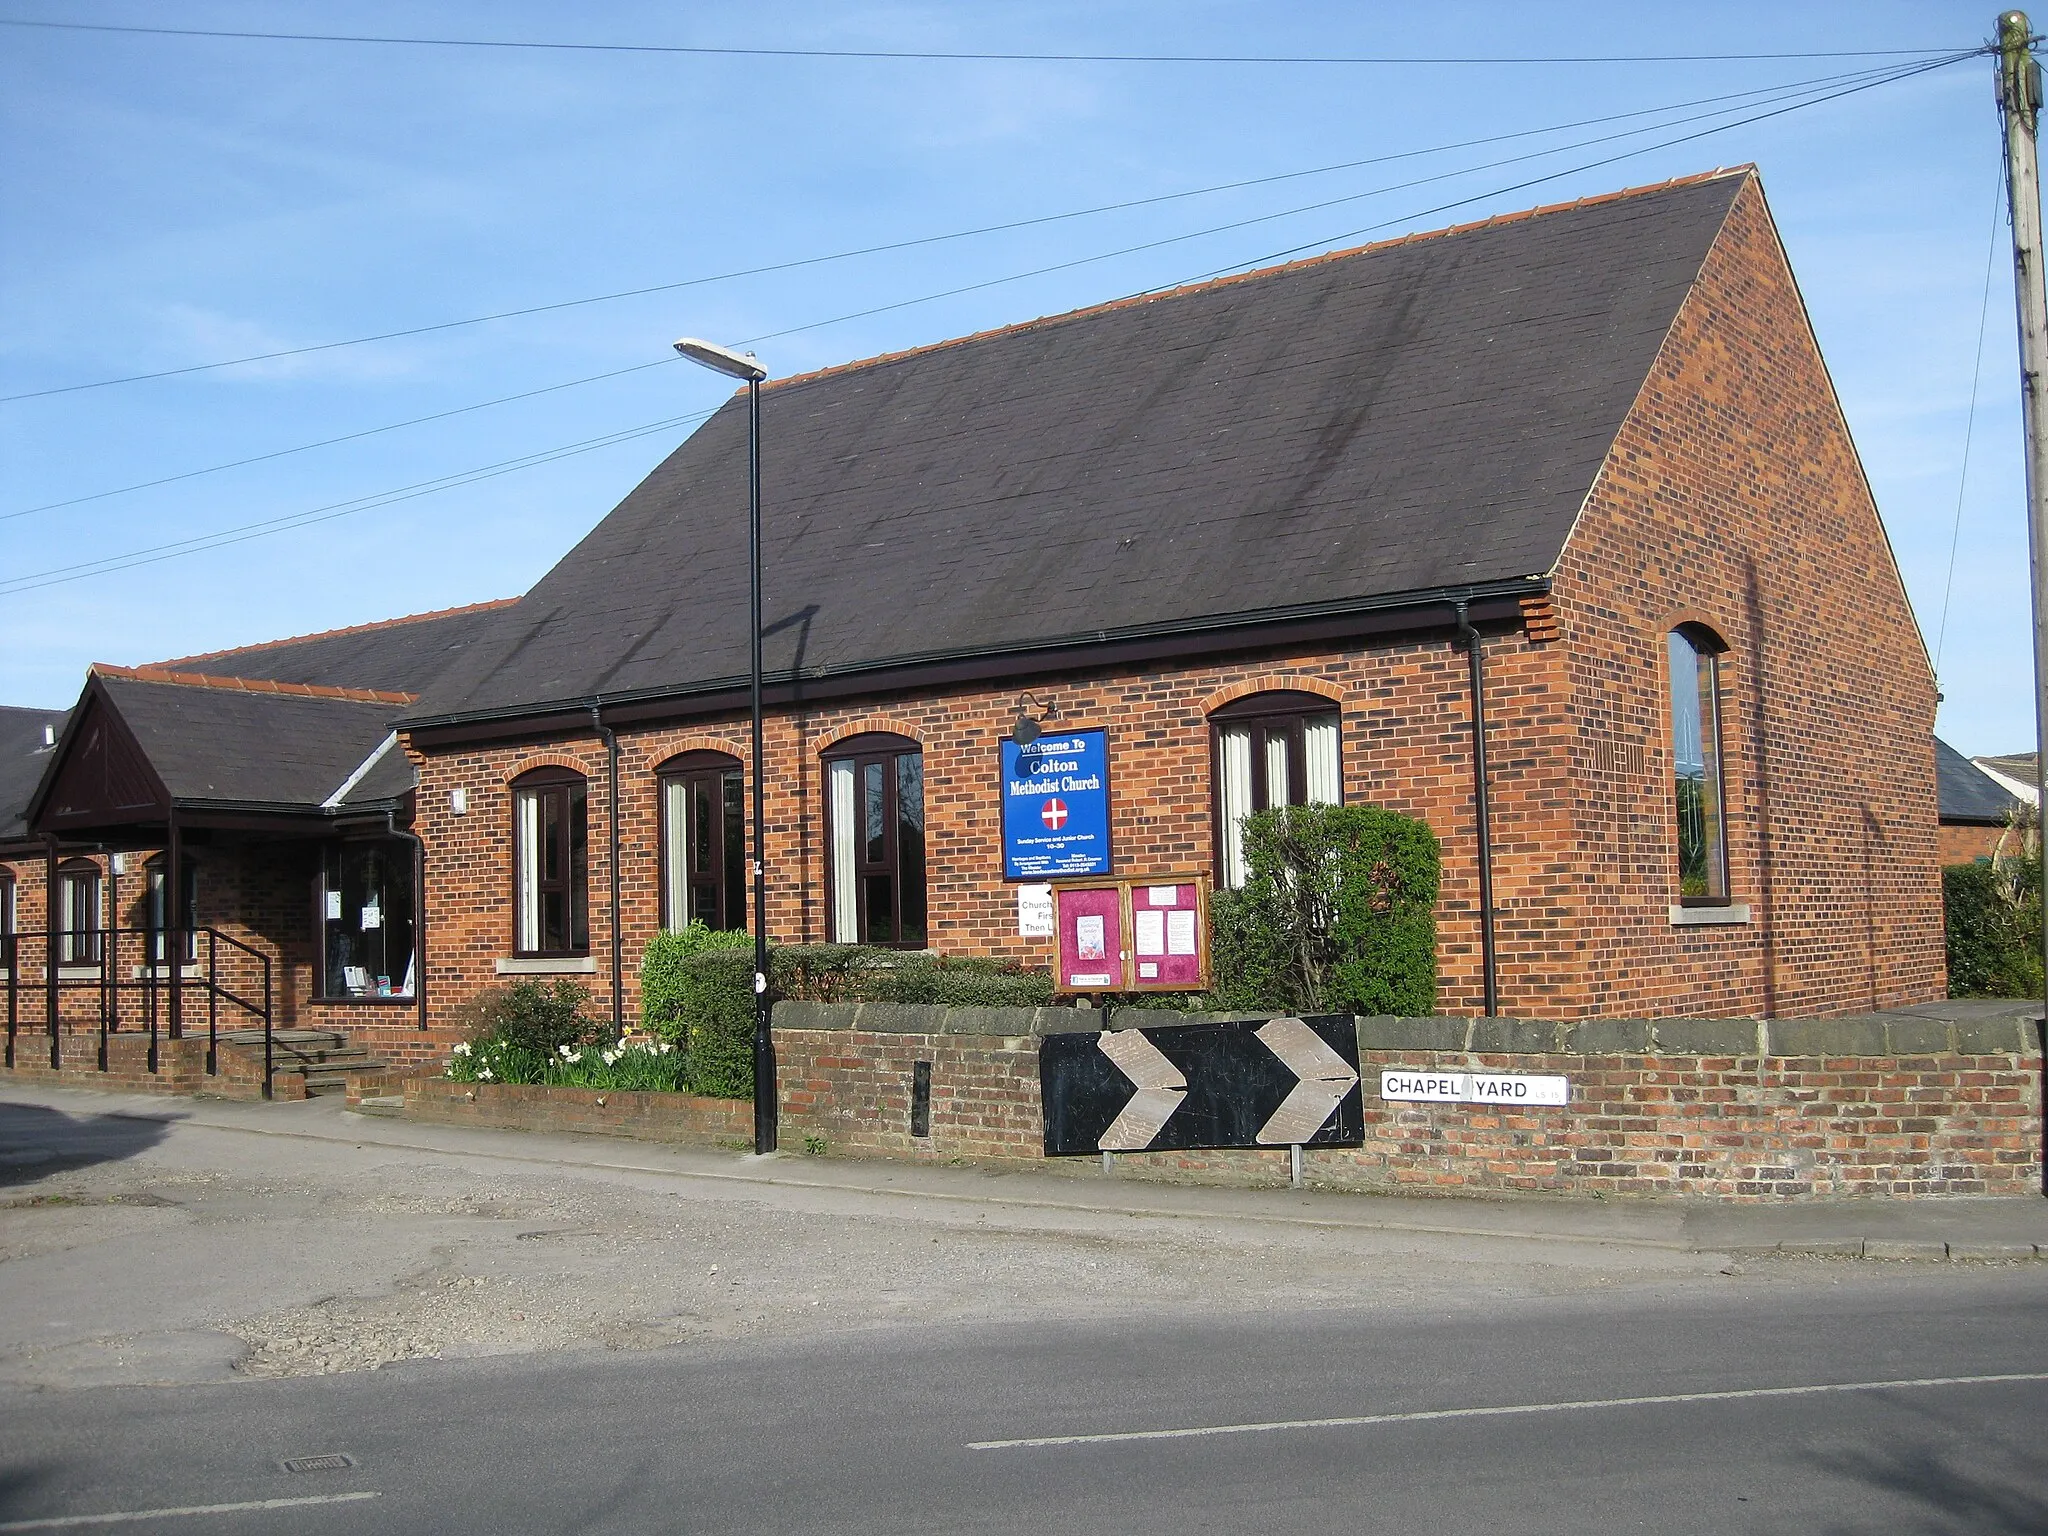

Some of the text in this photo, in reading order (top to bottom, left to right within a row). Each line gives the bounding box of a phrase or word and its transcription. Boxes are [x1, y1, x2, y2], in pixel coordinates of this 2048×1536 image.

[1021, 739, 1085, 753] Welcome To
[1030, 759, 1078, 775] Colton
[1010, 774, 1100, 796] Methodist Church
[1021, 901, 1053, 909] Church
[1037, 911, 1053, 920] Firs
[1025, 923, 1045, 931] Then
[1386, 1077, 1461, 1095] CHAPEL
[1475, 1080, 1527, 1098] YARD
